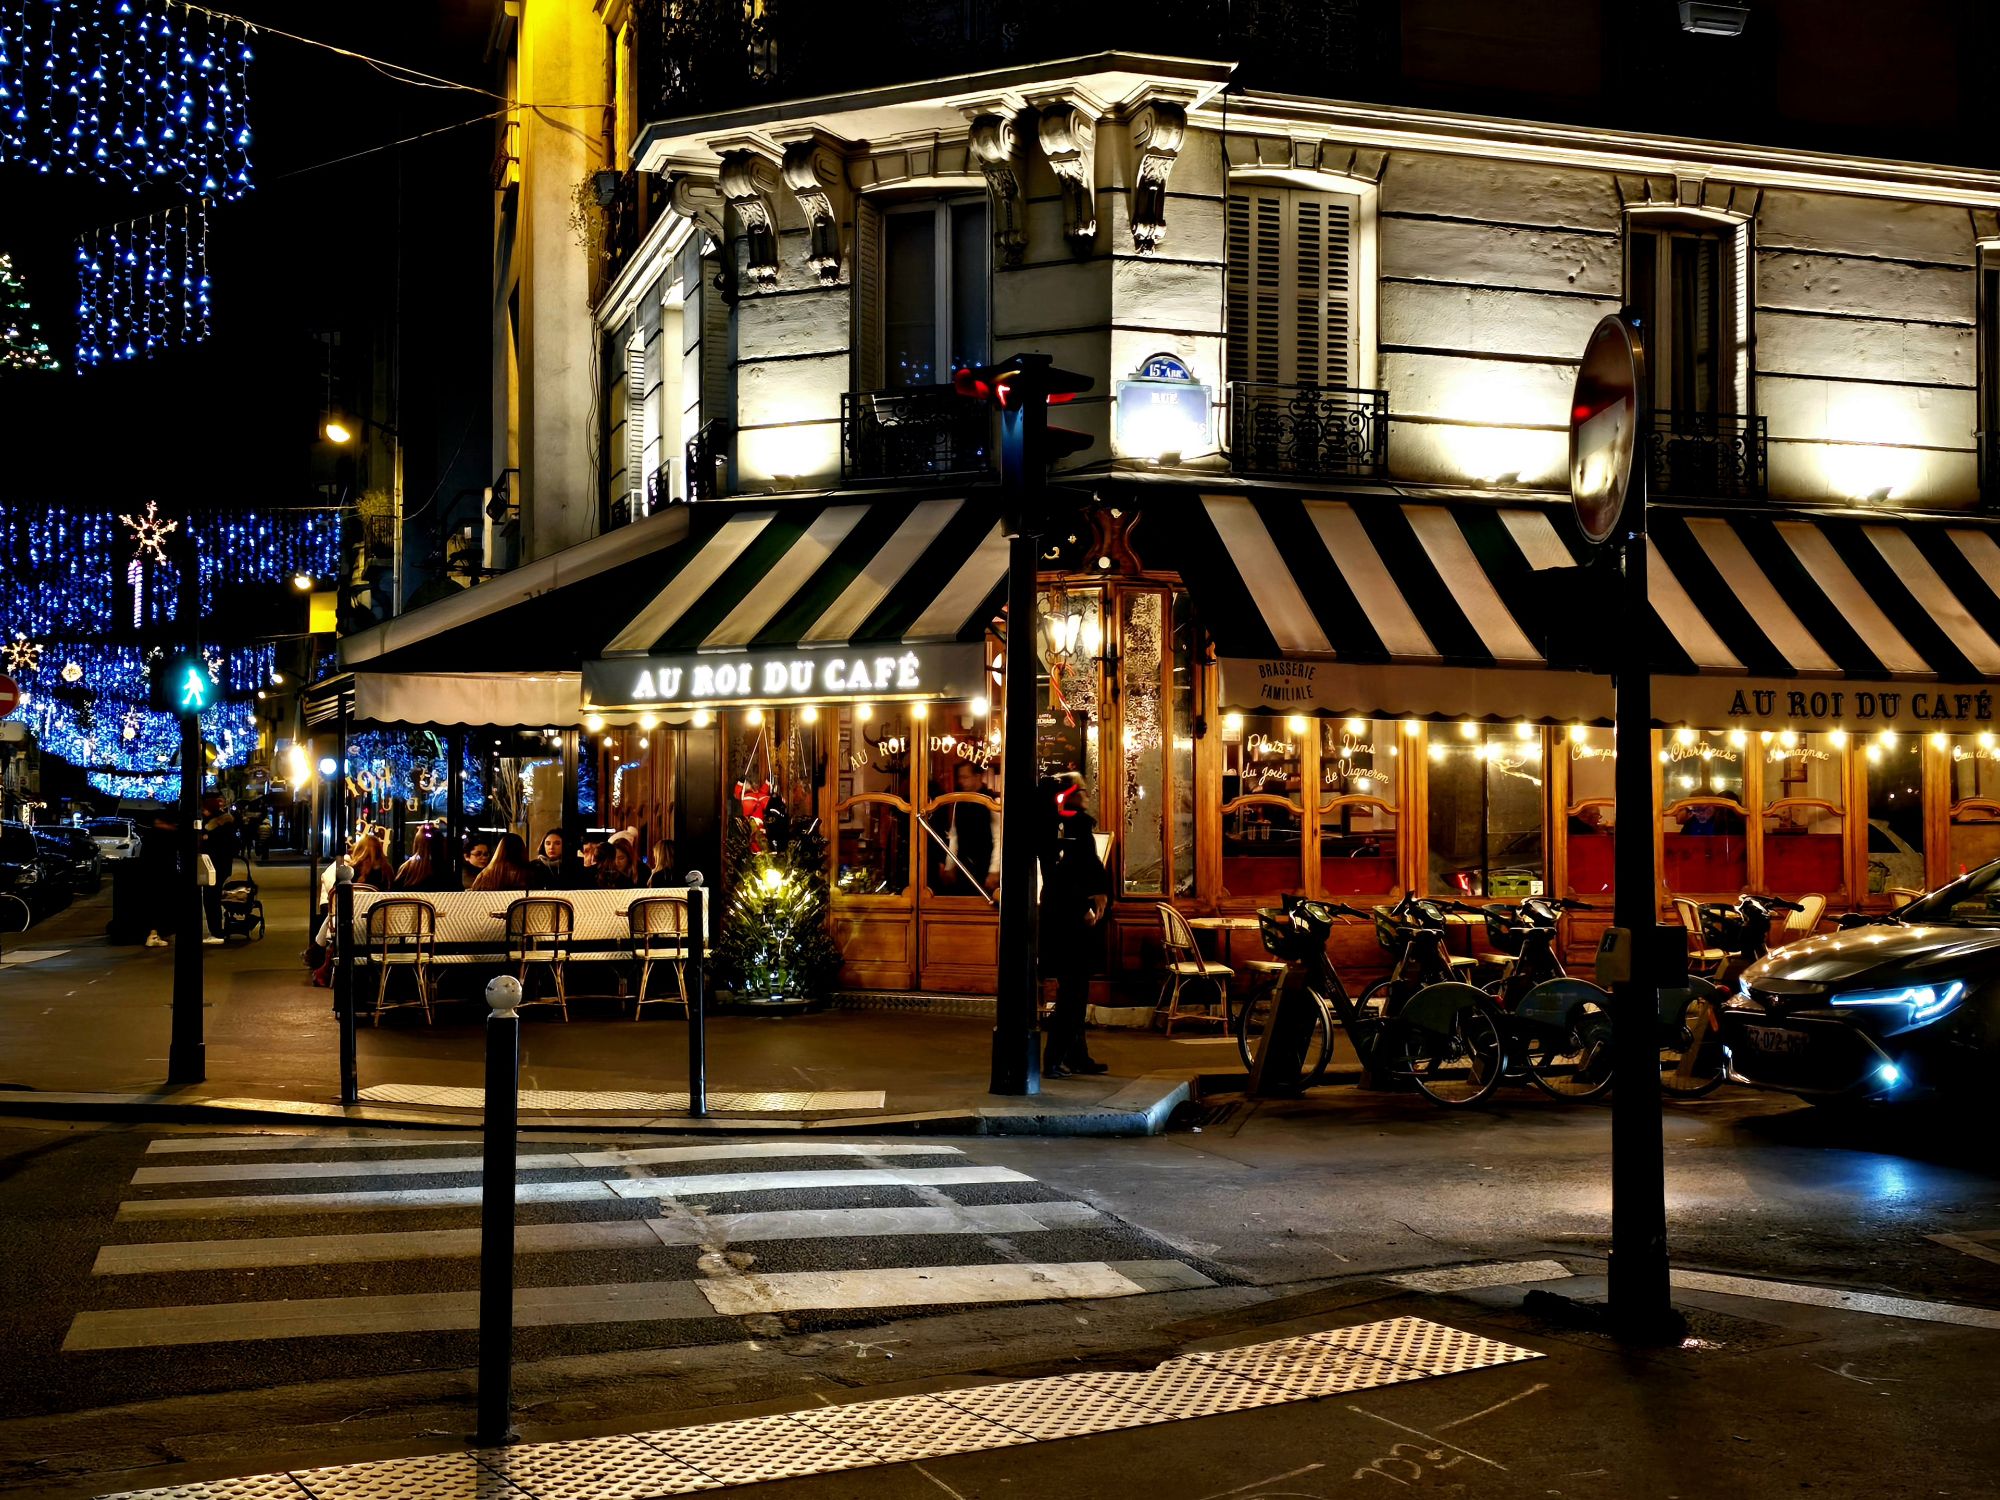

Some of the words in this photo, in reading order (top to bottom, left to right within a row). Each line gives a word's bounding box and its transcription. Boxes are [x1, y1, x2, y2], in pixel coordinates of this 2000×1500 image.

[632, 667, 682, 698] AU
[691, 663, 753, 696] ROI
[764, 660, 815, 693] DU
[824, 650, 920, 690] CAFÉ
[1258, 662, 1316, 681] BRASSERIE
[1261, 683, 1314, 701] FAMILIALE
[1727, 689, 1776, 718] AU
[1787, 691, 1845, 719] ROI
[1855, 692, 1902, 719] DU
[1912, 689, 1993, 720] CAFÉ
[850, 749, 869, 771] AU
[878, 736, 906, 757] ROI
[930, 735, 956, 754] DU
[1247, 733, 1286, 754] Plats
[1343, 733, 1376, 754] Vins
[1670, 740, 1737, 762] Chartreuse
[1242, 763, 1257, 779] du
[1258, 765, 1288, 785] jour
[1325, 768, 1338, 784] de
[1338, 758, 1390, 784] Vigneron
